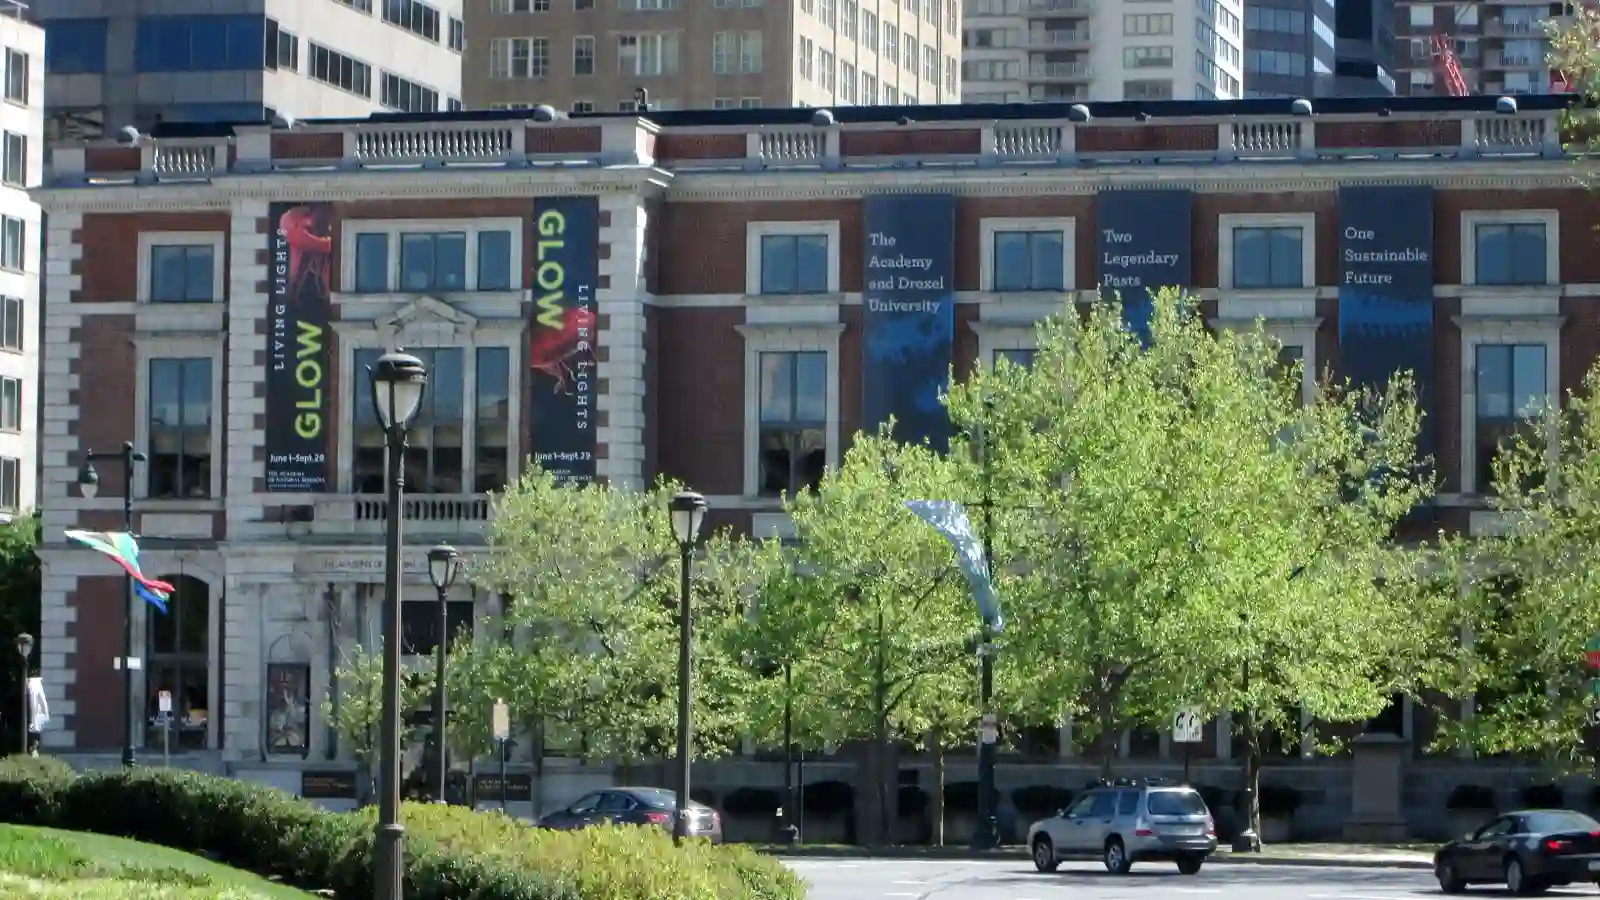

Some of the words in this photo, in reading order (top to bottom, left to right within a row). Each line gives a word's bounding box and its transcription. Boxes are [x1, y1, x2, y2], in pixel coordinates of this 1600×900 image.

[869, 232, 896, 246] The
[1103, 229, 1132, 243] Two
[1345, 226, 1375, 240] One
[276, 229, 287, 294] LIGHTS
[1103, 250, 1179, 267] Legendary
[1344, 247, 1428, 261] Sustainable
[868, 254, 933, 270] Academy
[537, 210, 565, 330] GLOW
[1344, 271, 1393, 284] Future
[868, 276, 894, 290] and
[898, 276, 944, 289] Drexel
[868, 299, 940, 314] University
[577, 285, 589, 351] LIVING
[275, 305, 285, 370] LIVING
[295, 320, 322, 438] GLOW
[576, 360, 588, 430] LIGHTS
[270, 454, 287, 463] June
[535, 452, 552, 462] June
